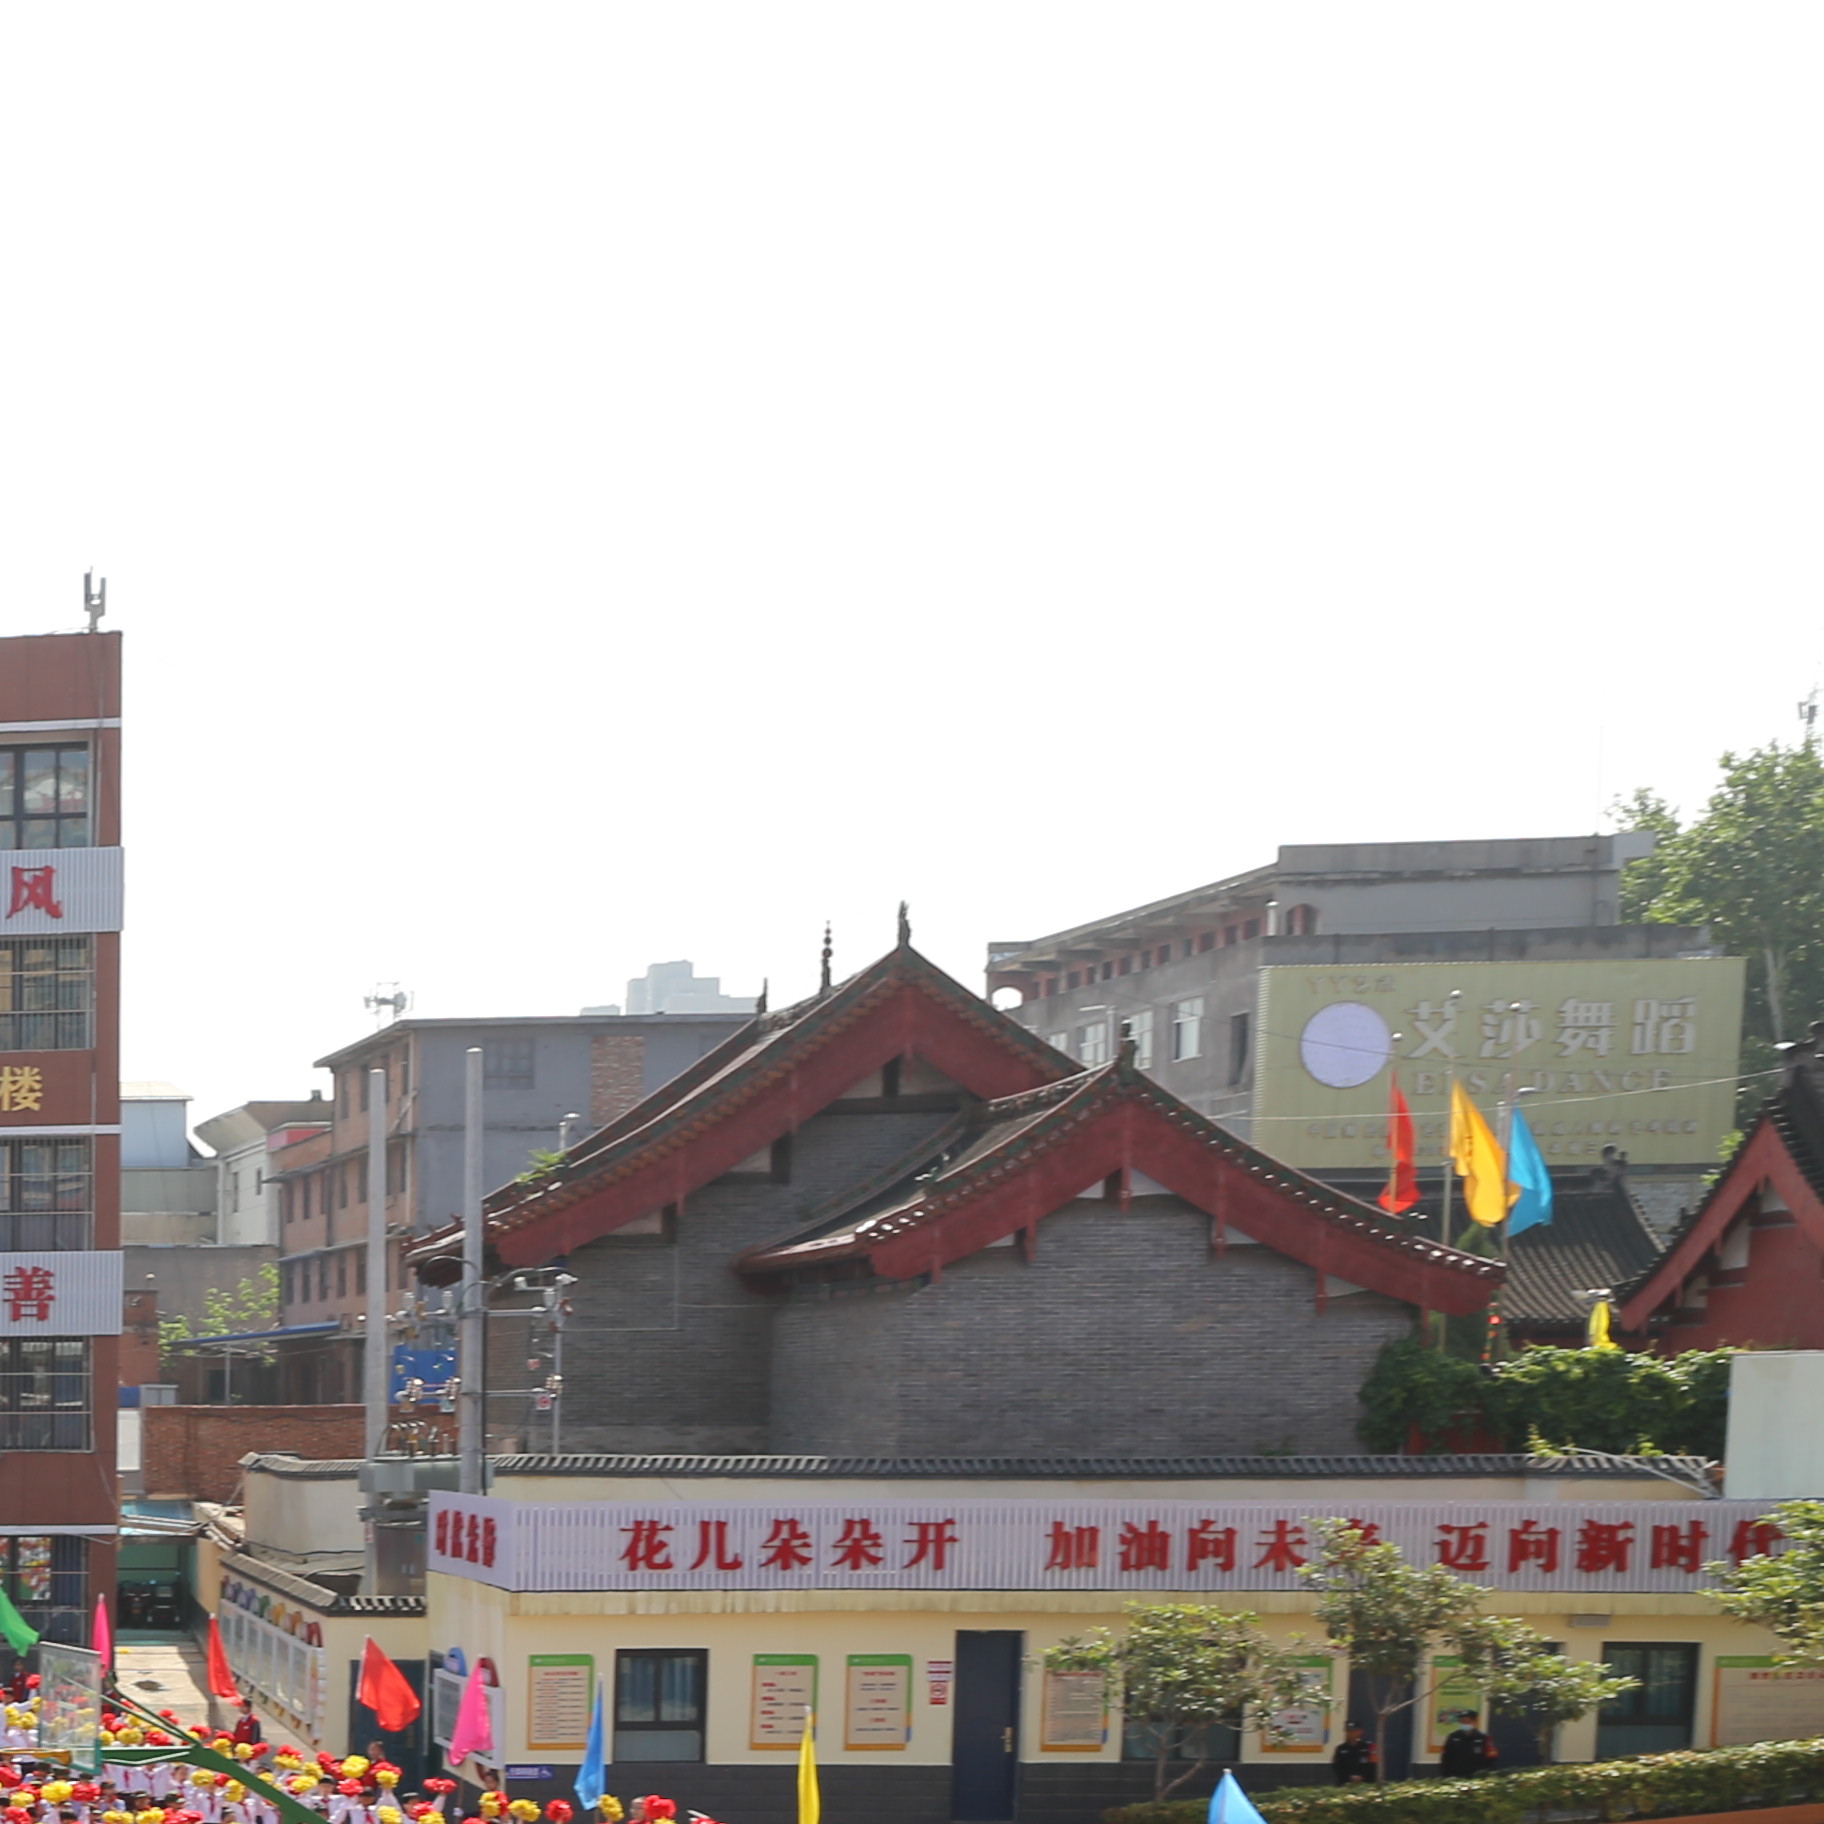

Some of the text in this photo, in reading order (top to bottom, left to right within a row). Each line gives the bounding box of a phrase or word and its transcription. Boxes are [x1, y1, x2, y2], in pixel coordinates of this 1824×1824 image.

[1533, 1068, 1674, 1093] DANCE
[620, 1517, 960, 1572] 花儿朵朵开
